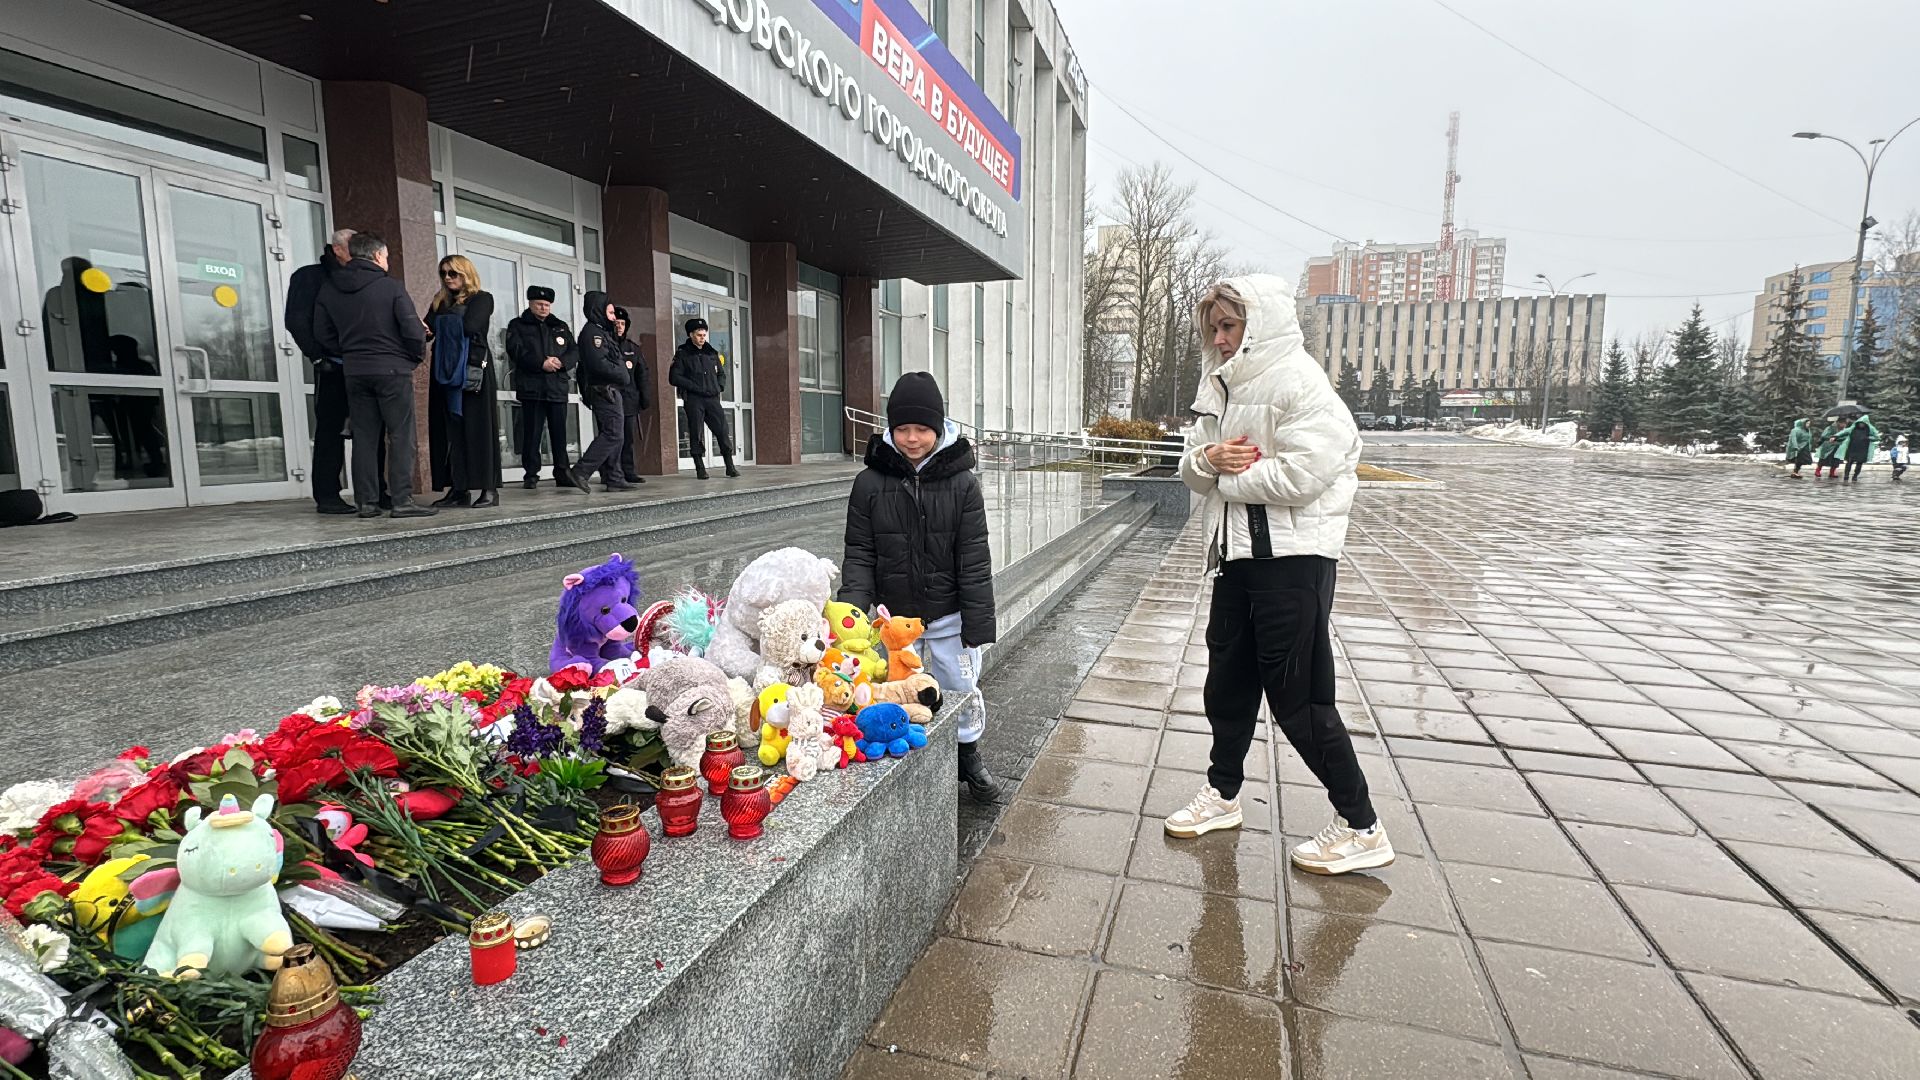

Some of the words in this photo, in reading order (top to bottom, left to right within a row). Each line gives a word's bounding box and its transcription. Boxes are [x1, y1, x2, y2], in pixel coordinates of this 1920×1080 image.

[864, 93, 970, 207] ГОРОДСКОГО
[971, 187, 1008, 238] ОКРУГА
[872, 20, 926, 108] ВЕРА
[930, 83, 943, 121] В
[947, 100, 1009, 187] БУДУЩЕЕ
[205, 264, 237, 278] ВХОД
